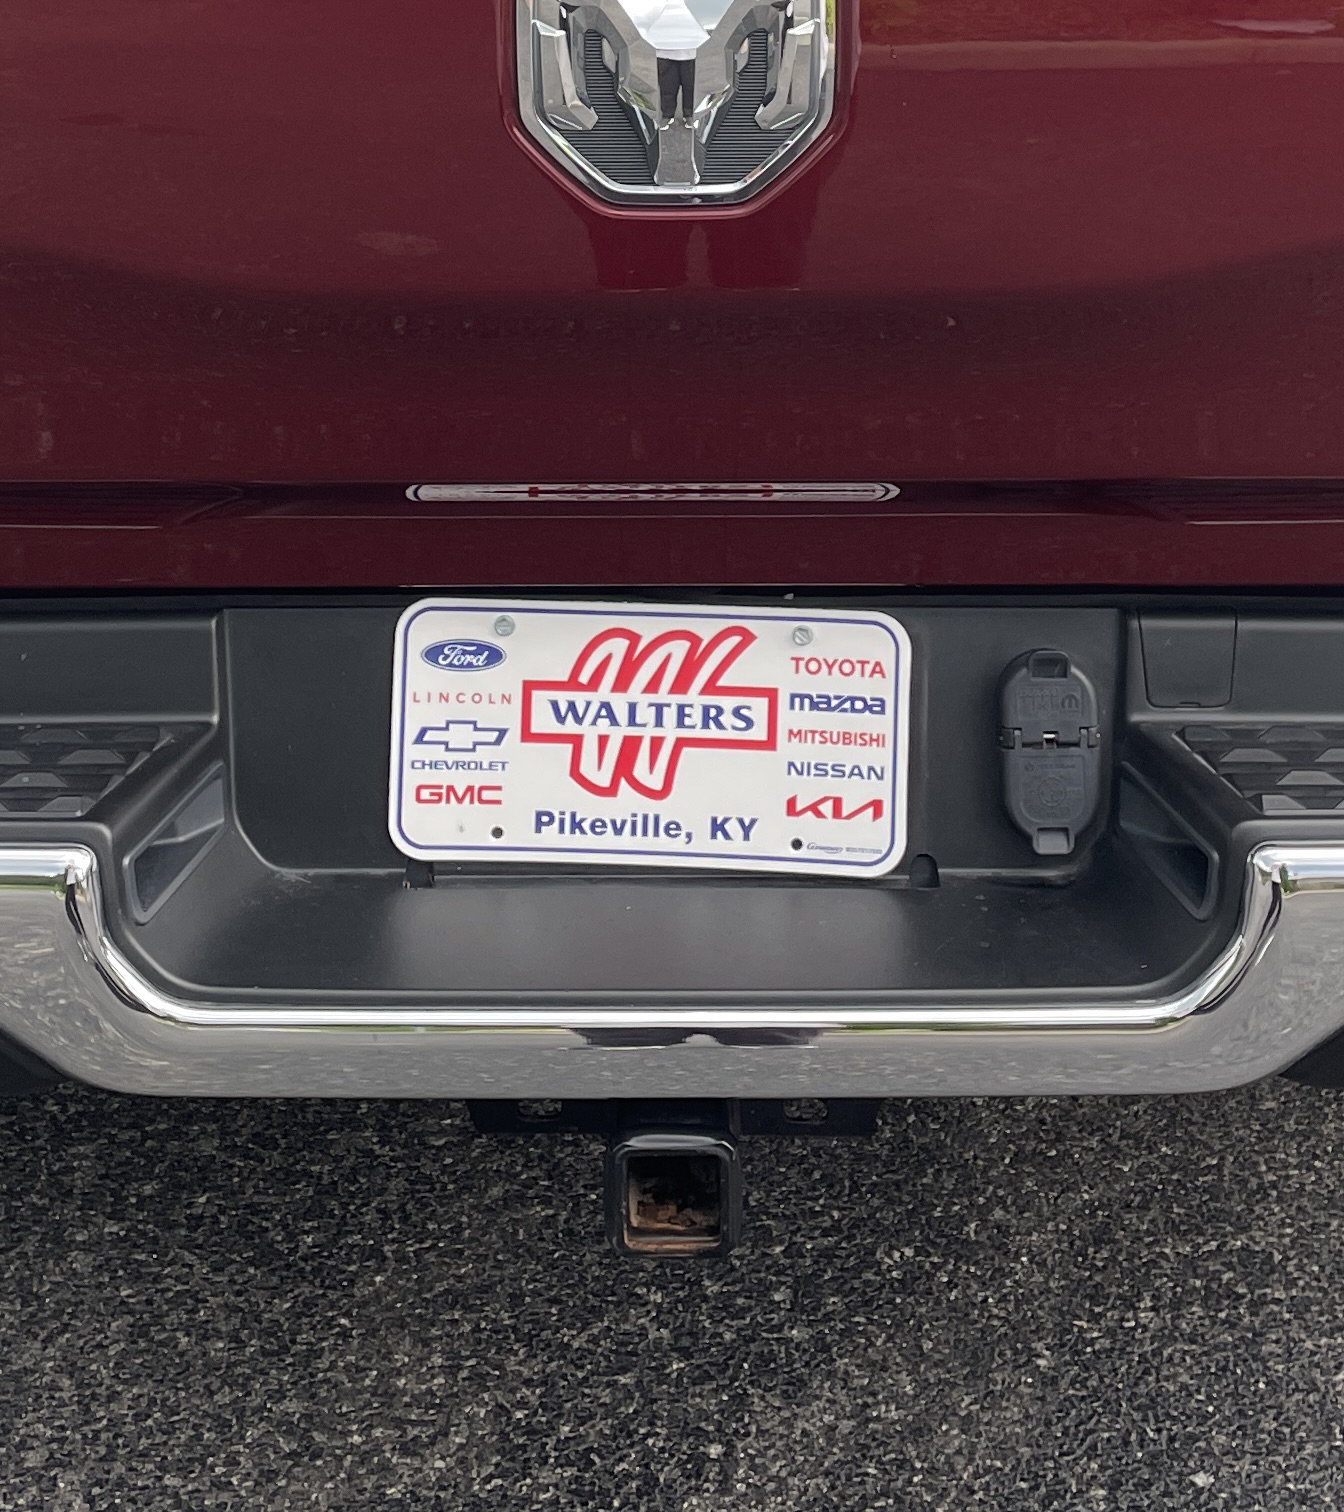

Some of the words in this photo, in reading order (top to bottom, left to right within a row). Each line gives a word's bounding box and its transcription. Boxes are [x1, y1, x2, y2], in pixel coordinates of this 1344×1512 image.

[437, 644, 490, 666] Ford
[791, 656, 887, 680] TOYOTA
[412, 691, 512, 705] LINCOLN
[548, 698, 756, 733] WALTERS
[787, 728, 887, 749] MITSUBISHI
[411, 759, 509, 772] CHEVROLET
[787, 761, 886, 781] NISSAN
[414, 784, 503, 805] GMC
[534, 810, 694, 845] Pikeville,
[709, 817, 758, 842] KY
